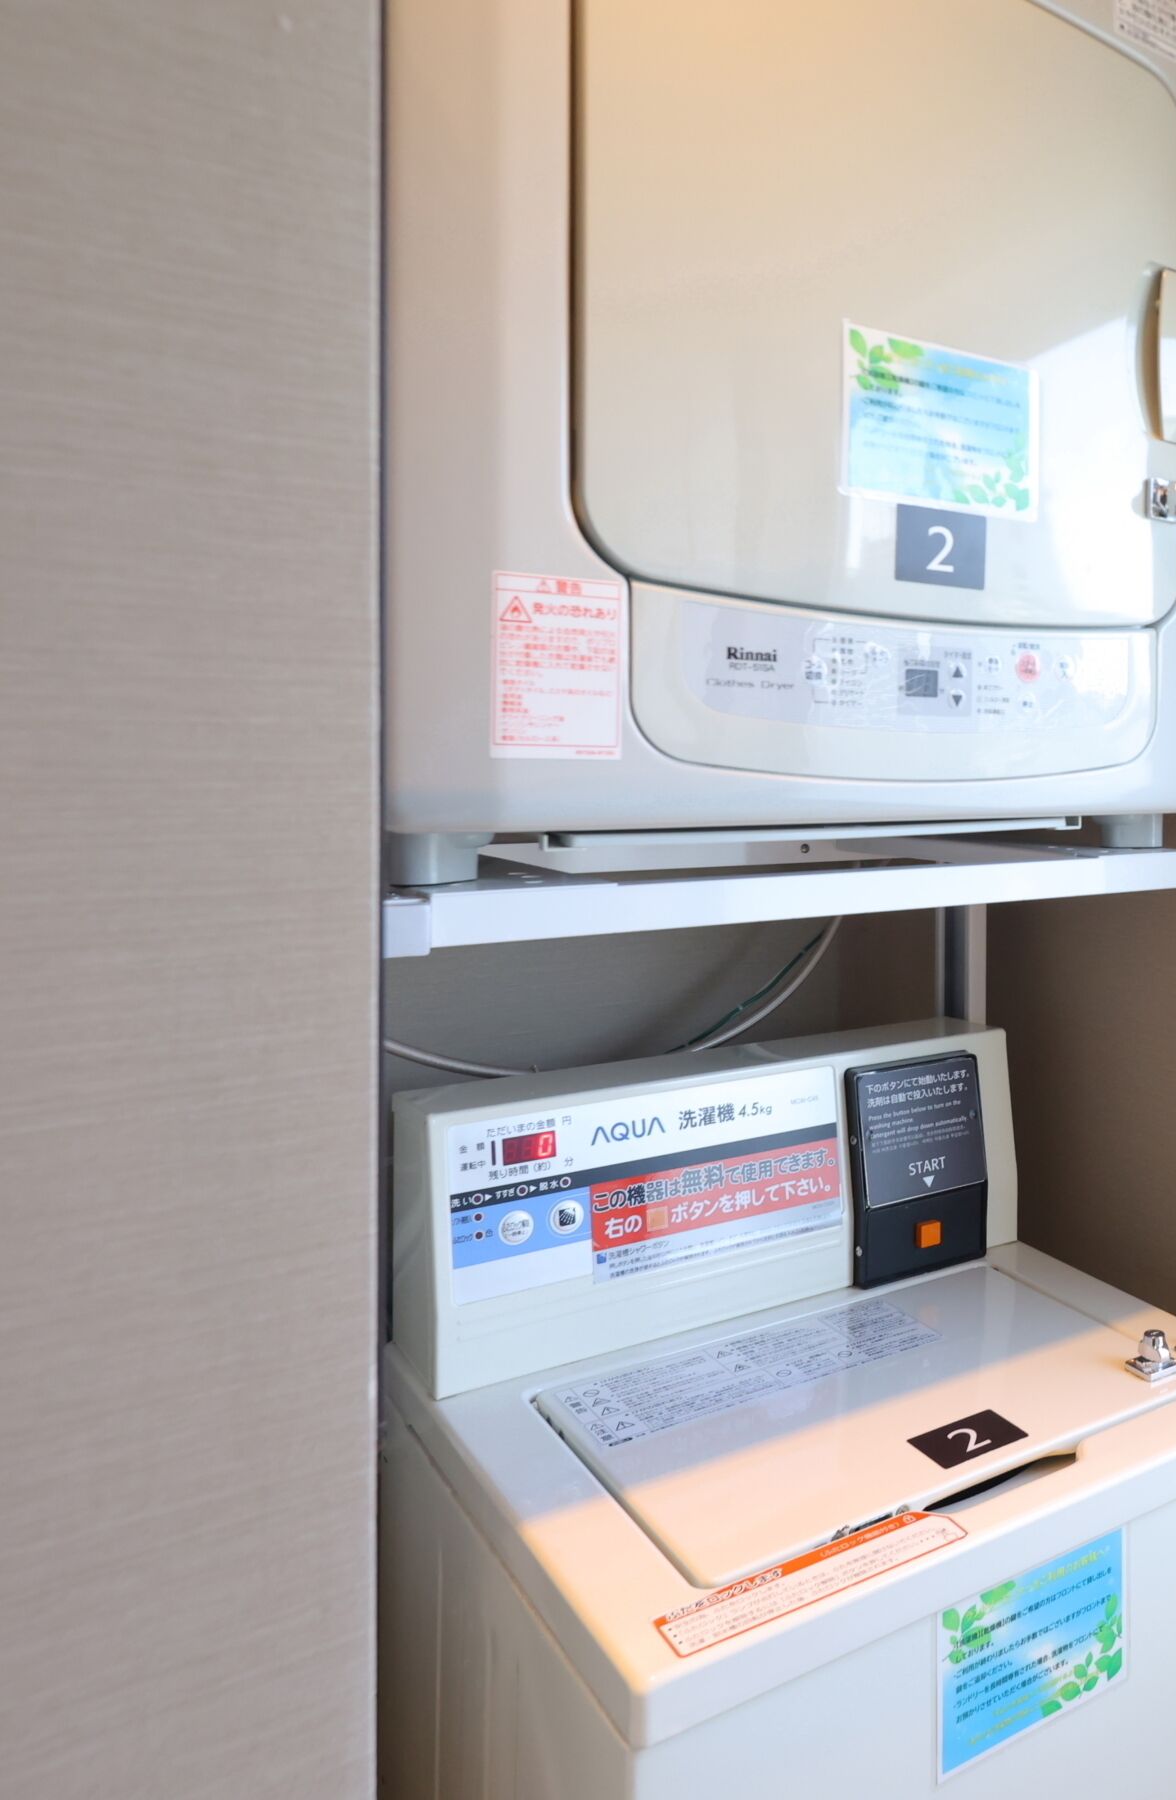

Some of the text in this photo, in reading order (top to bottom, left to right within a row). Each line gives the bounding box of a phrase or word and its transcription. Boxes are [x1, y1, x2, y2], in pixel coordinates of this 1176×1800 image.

[926, 525, 954, 573] 2
[726, 646, 777, 662] Rinnai
[706, 678, 795, 690] Clothes Dryer
[865, 1070, 970, 1095] 下のボタンにて始動いたします。
[867, 1083, 968, 1109] 洗剤は自動で投入いたします。
[678, 1102, 772, 1130] 洗濯機 4.5kg
[868, 1113, 882, 1122] Press
[893, 1108, 910, 1117] button
[911, 1106, 927, 1114] below
[934, 1102, 944, 1110] turn
[487, 1115, 572, 1138] ただいまの金額 円
[590, 1116, 666, 1146] AQUA
[869, 1122, 890, 1132] washing
[897, 1126, 906, 1134] will
[907, 1124, 919, 1133] drop
[920, 1122, 934, 1130] down
[538, 1134, 553, 1157] 0
[564, 1157, 574, 1166] 分
[908, 1156, 946, 1176] START
[539, 1180, 559, 1191] 脱水
[593, 1149, 837, 1213] この機器は無料で使用できます。
[495, 1188, 515, 1200] すすぎ
[604, 1176, 832, 1240] 右の ボタンを押して下さい。
[946, 1428, 992, 1453] 2
